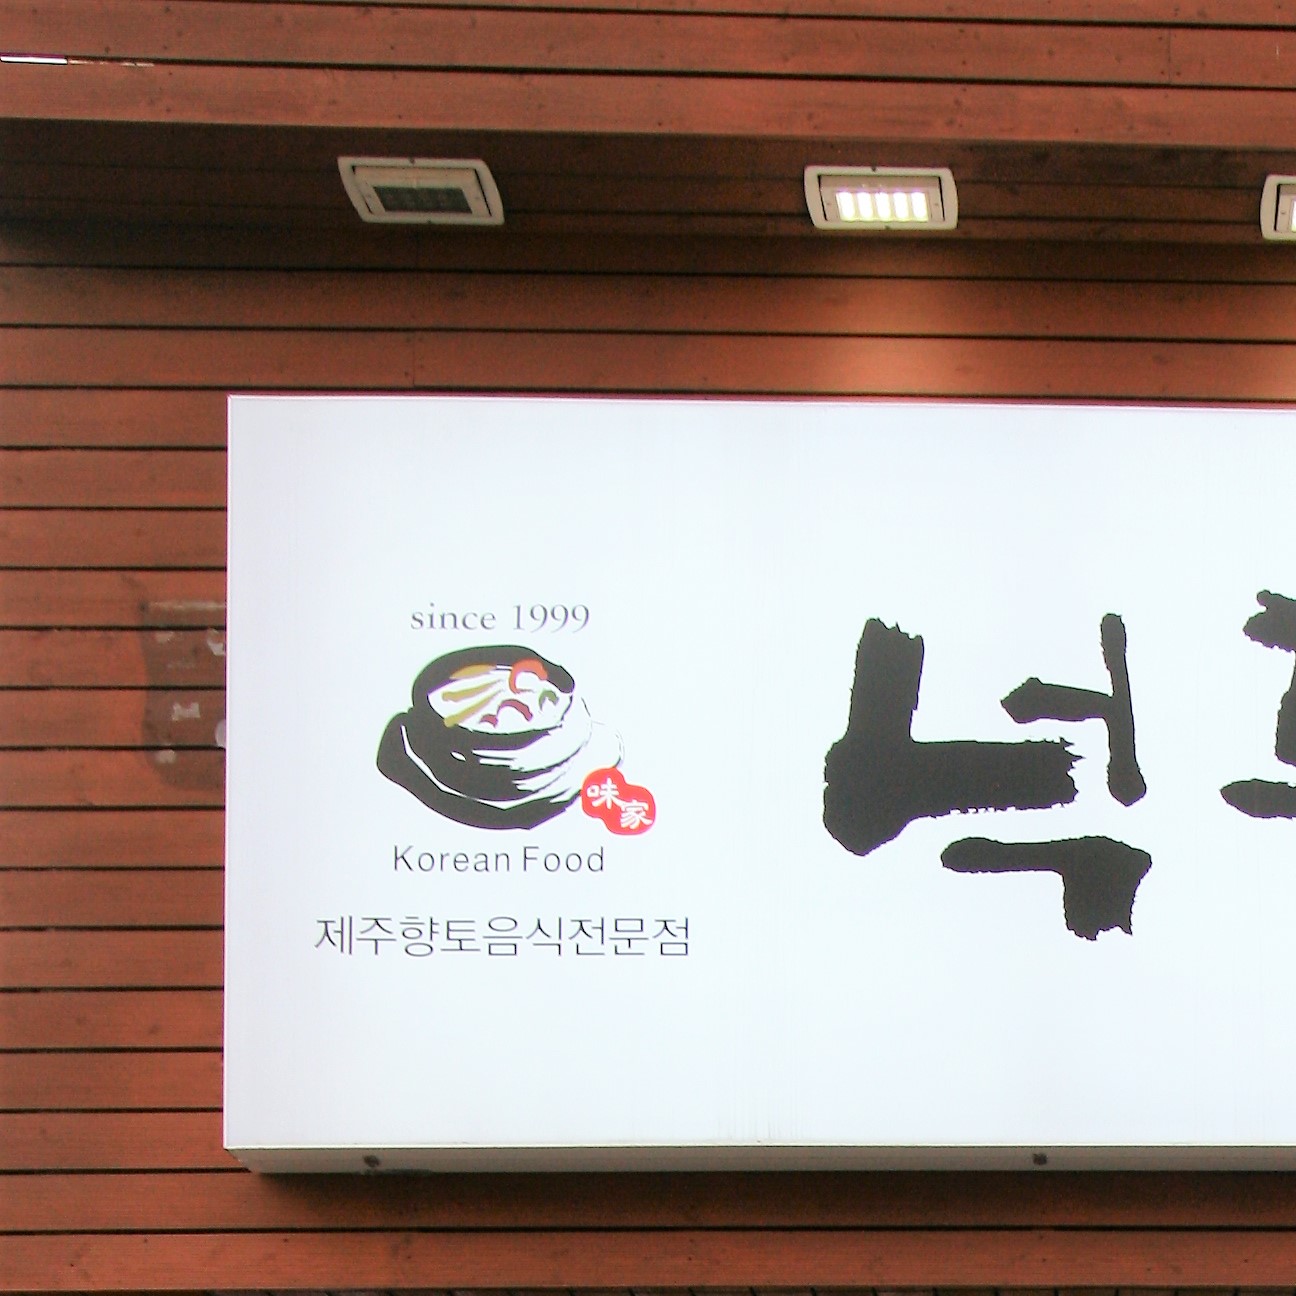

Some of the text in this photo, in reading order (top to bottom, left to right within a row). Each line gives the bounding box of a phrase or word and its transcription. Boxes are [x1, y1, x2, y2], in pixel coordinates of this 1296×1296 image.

[410, 603, 592, 631] since 1999
[585, 776, 654, 830] 味家
[393, 845, 605, 874] Korean Food
[313, 914, 691, 959] 제주향토음식전문점
